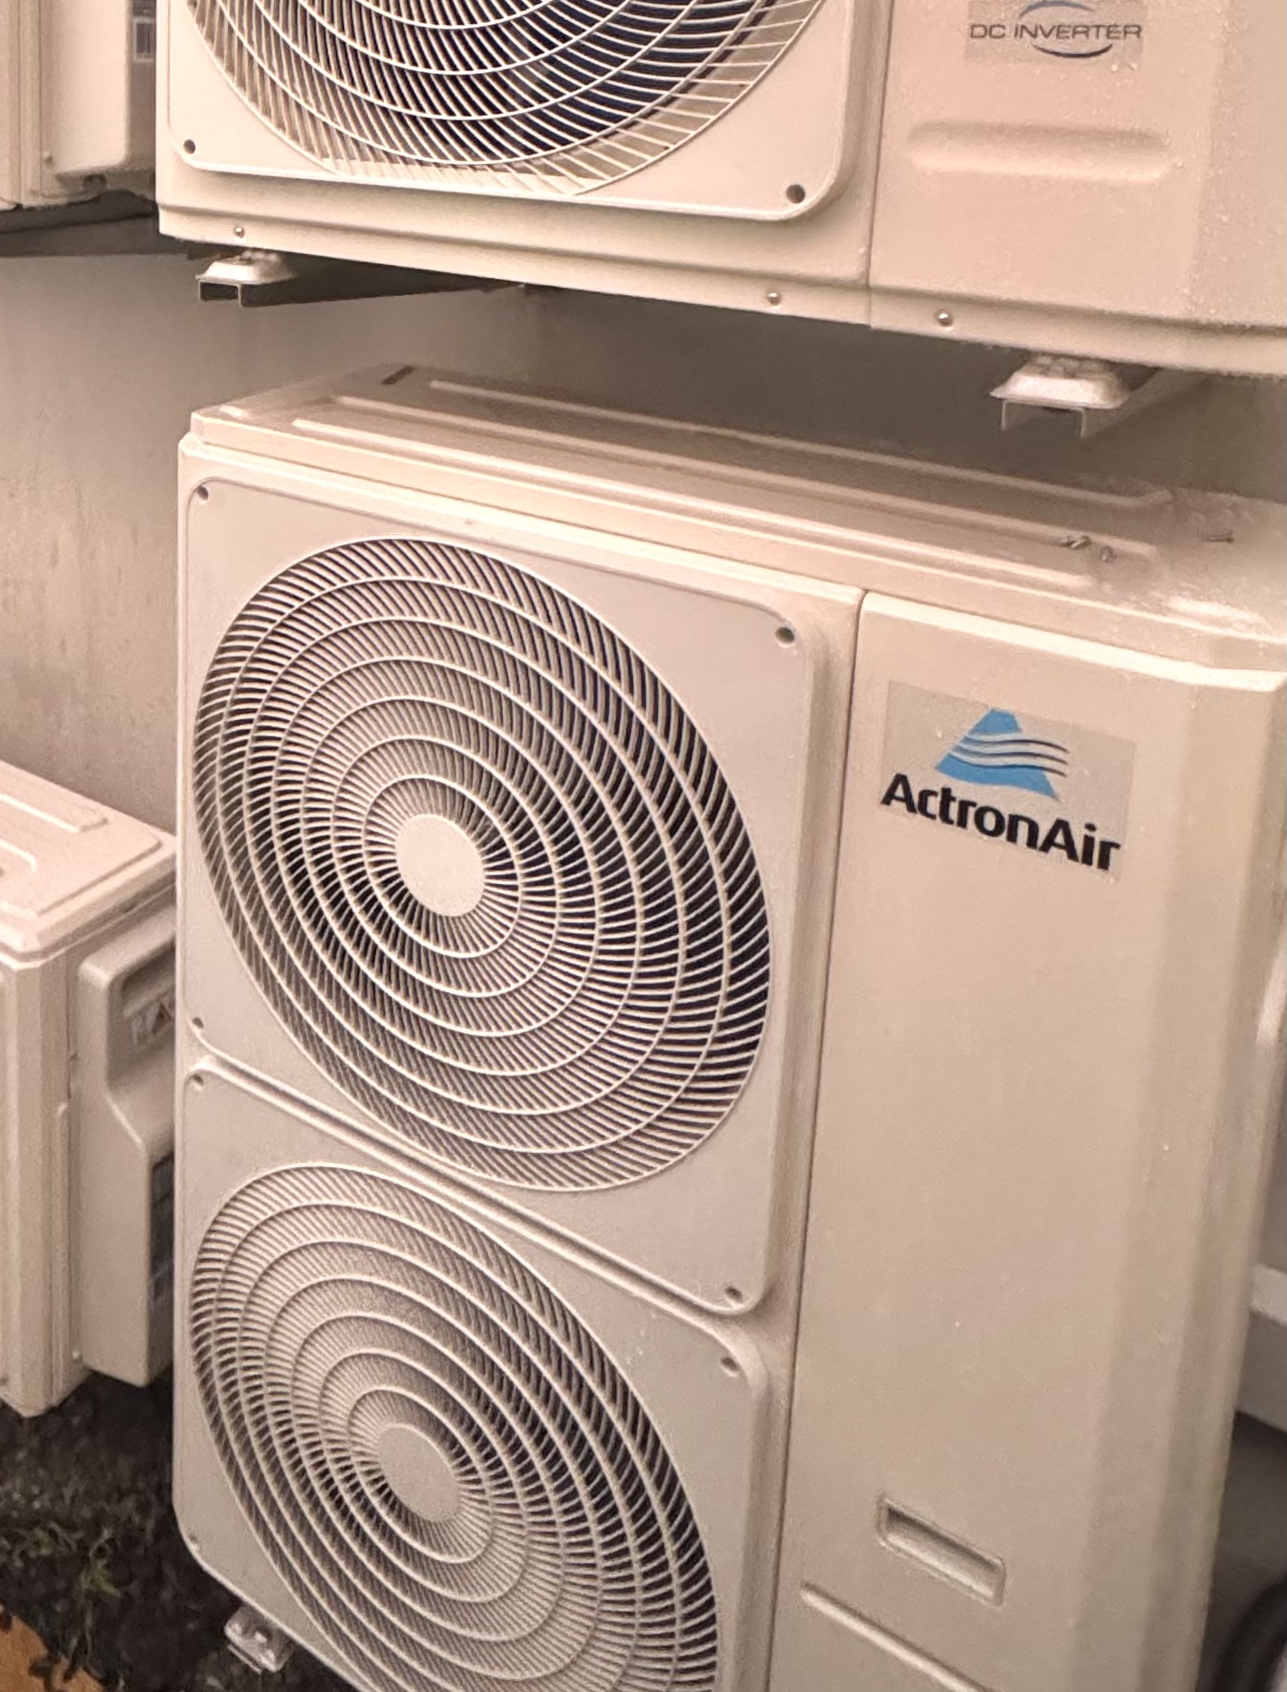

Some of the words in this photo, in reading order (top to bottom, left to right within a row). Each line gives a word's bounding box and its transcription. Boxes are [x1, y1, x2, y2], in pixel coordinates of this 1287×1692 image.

[970, 24, 1005, 39] DC
[1015, 24, 1142, 39] INVERTER
[880, 773, 1121, 871] ActronAir
